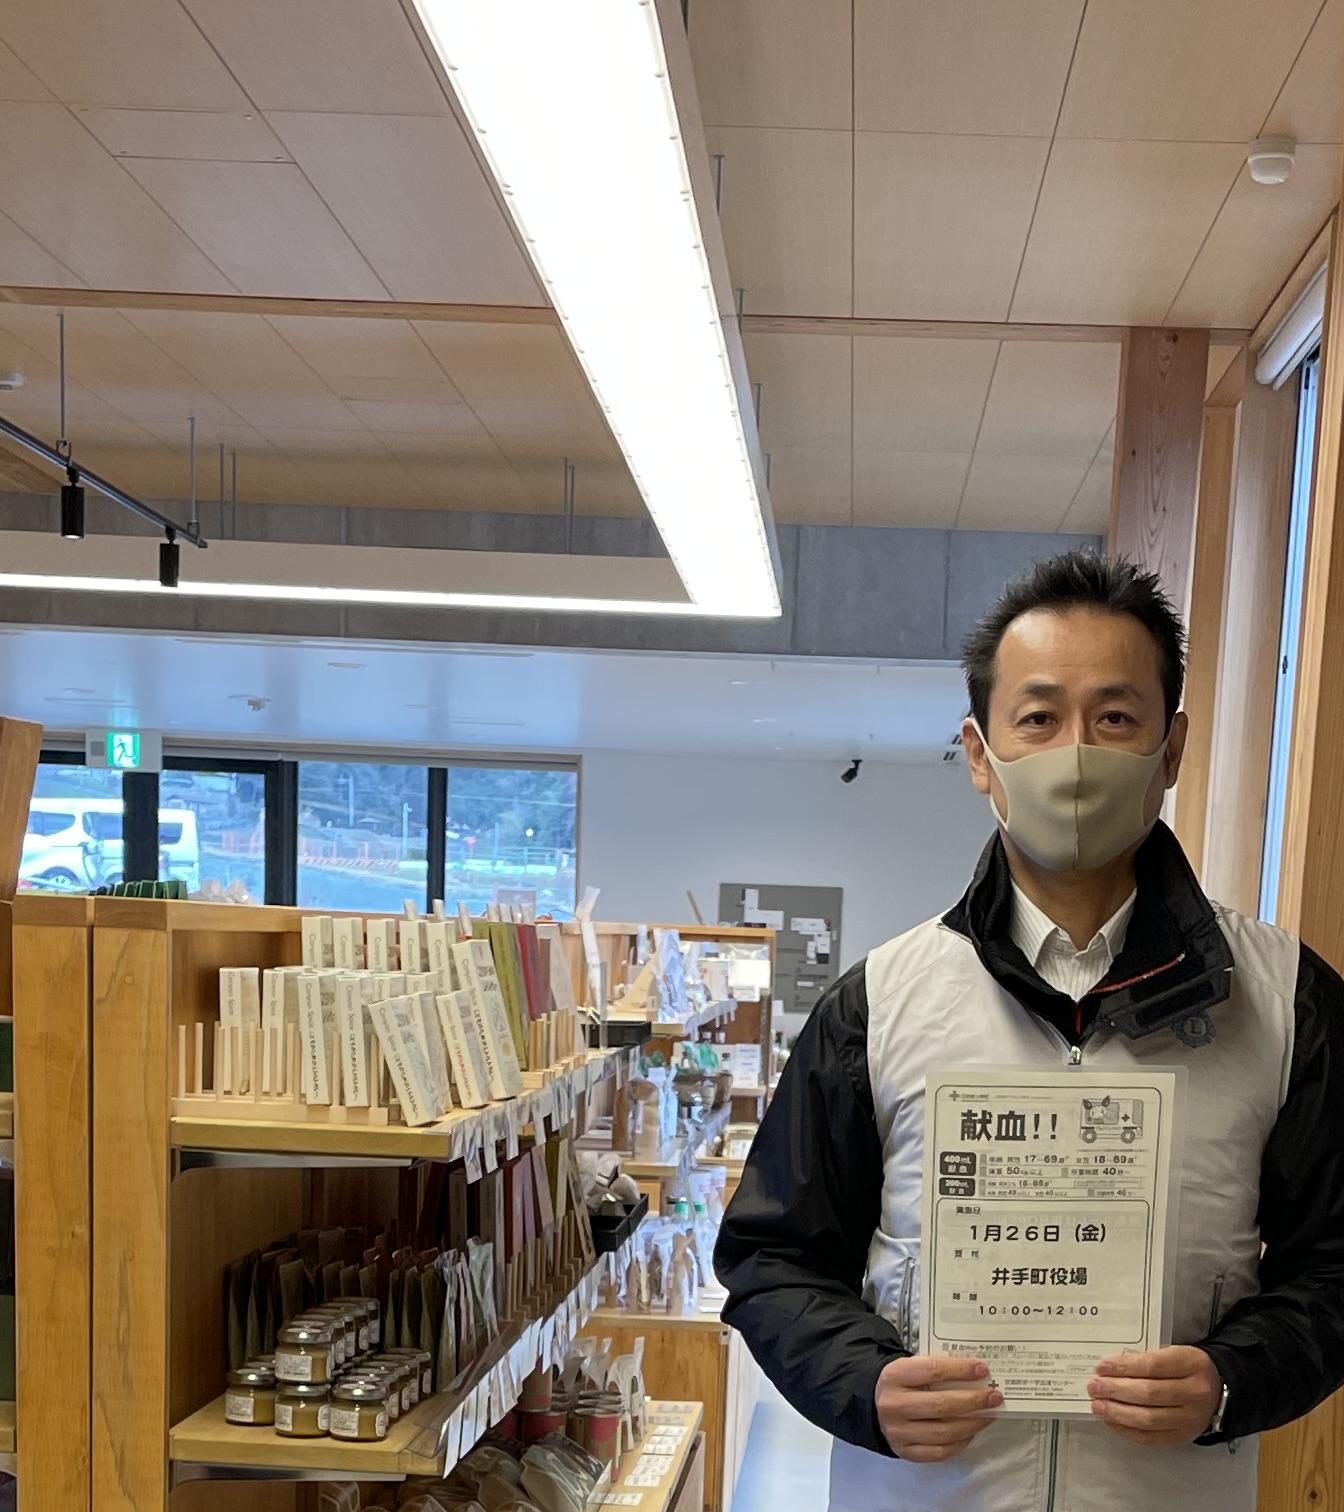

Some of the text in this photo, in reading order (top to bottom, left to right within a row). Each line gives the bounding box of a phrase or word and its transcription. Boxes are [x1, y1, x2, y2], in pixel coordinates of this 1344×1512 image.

[991, 1267, 1089, 1287] 井手町役場
